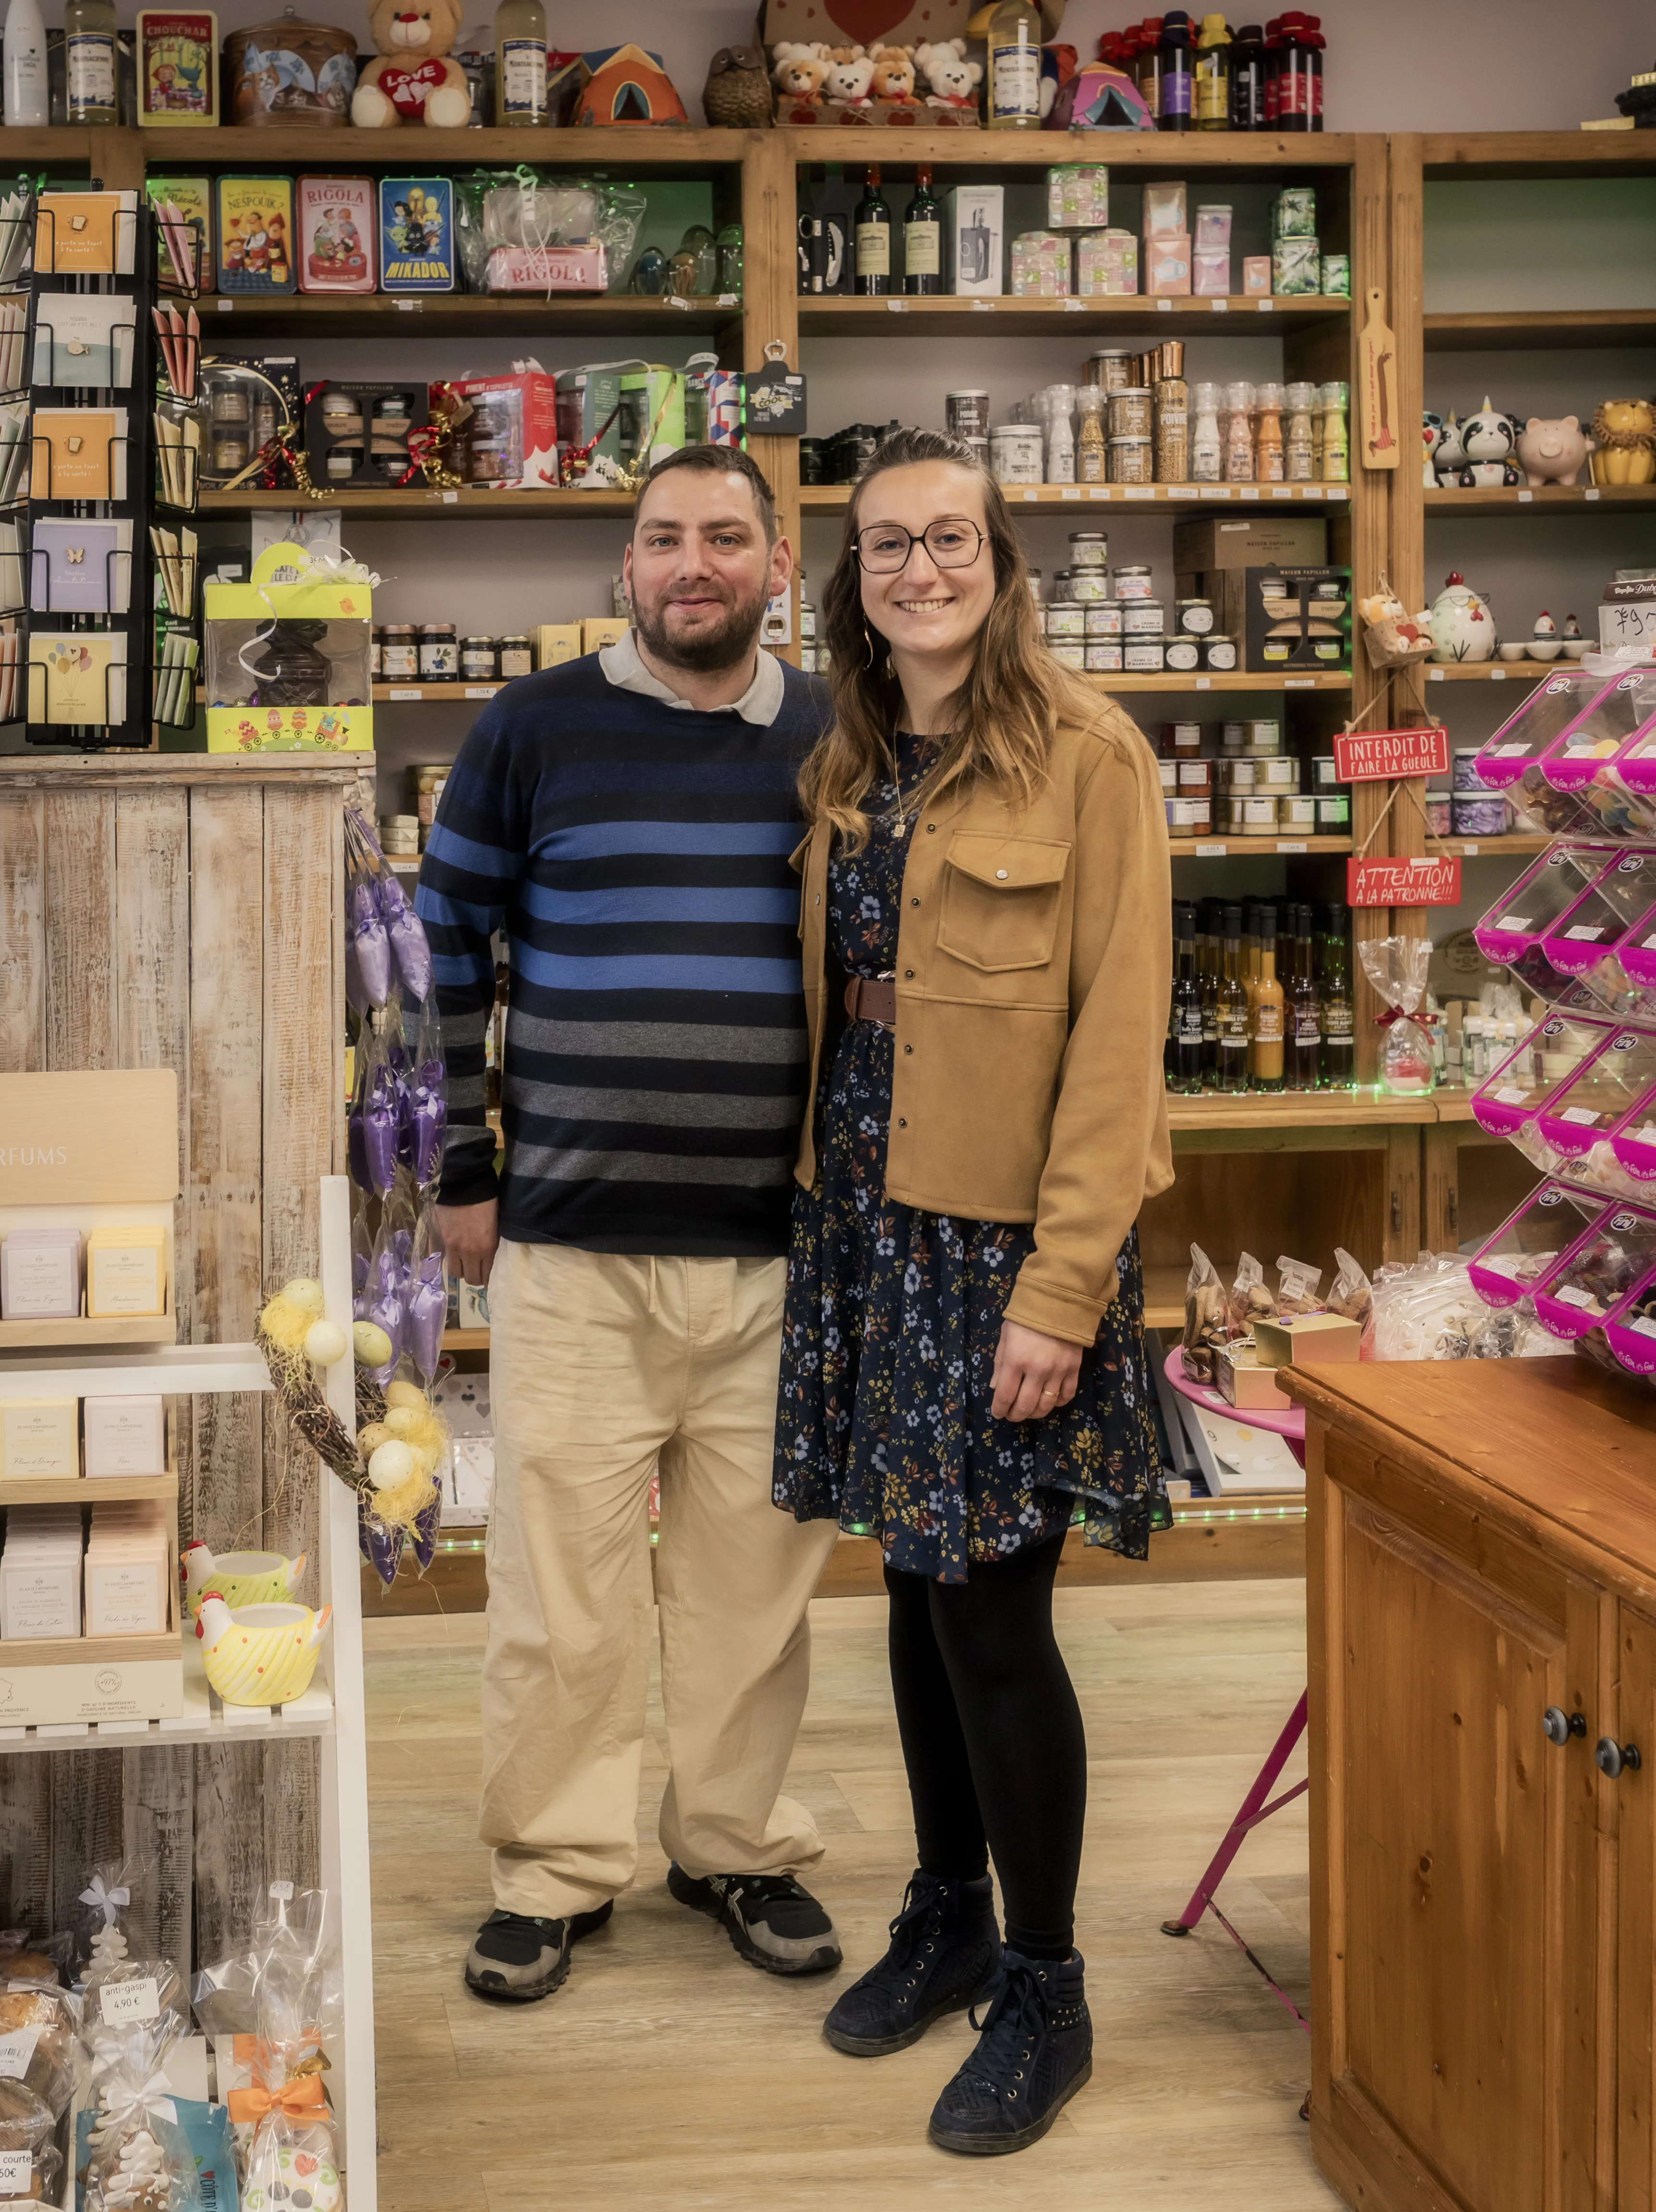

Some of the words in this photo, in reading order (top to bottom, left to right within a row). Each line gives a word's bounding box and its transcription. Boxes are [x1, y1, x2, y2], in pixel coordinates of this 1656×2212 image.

[146, 25, 208, 37] CHOUCHAR
[386, 65, 436, 88] LOVE
[306, 188, 364, 203] RIGOLA
[385, 262, 451, 279] MIKADOR
[510, 264, 587, 284] RIGOLA
[759, 396, 783, 408] COOL
[57, 463, 74, 472] porte
[1349, 738, 1414, 760] INTERDIT
[1420, 736, 1437, 753] DE
[1351, 761, 1381, 775] FAIRE
[1385, 757, 1398, 773] LA
[1402, 755, 1437, 771] GUEULE
[1356, 865, 1454, 889] ATTENTION
[1356, 890, 1364, 904] A
[1366, 889, 1378, 903] LA
[1380, 886, 1453, 902] PATRONNE!!!
[17, 1619, 36, 1629] Fleur
[105, 1980, 147, 1996] anti-gaspi
[114, 1998, 132, 2010] 4,90
[134, 1997, 140, 2006] €
[3, 2155, 32, 2163] courte
[200, 2179, 219, 2200] CÔTE
